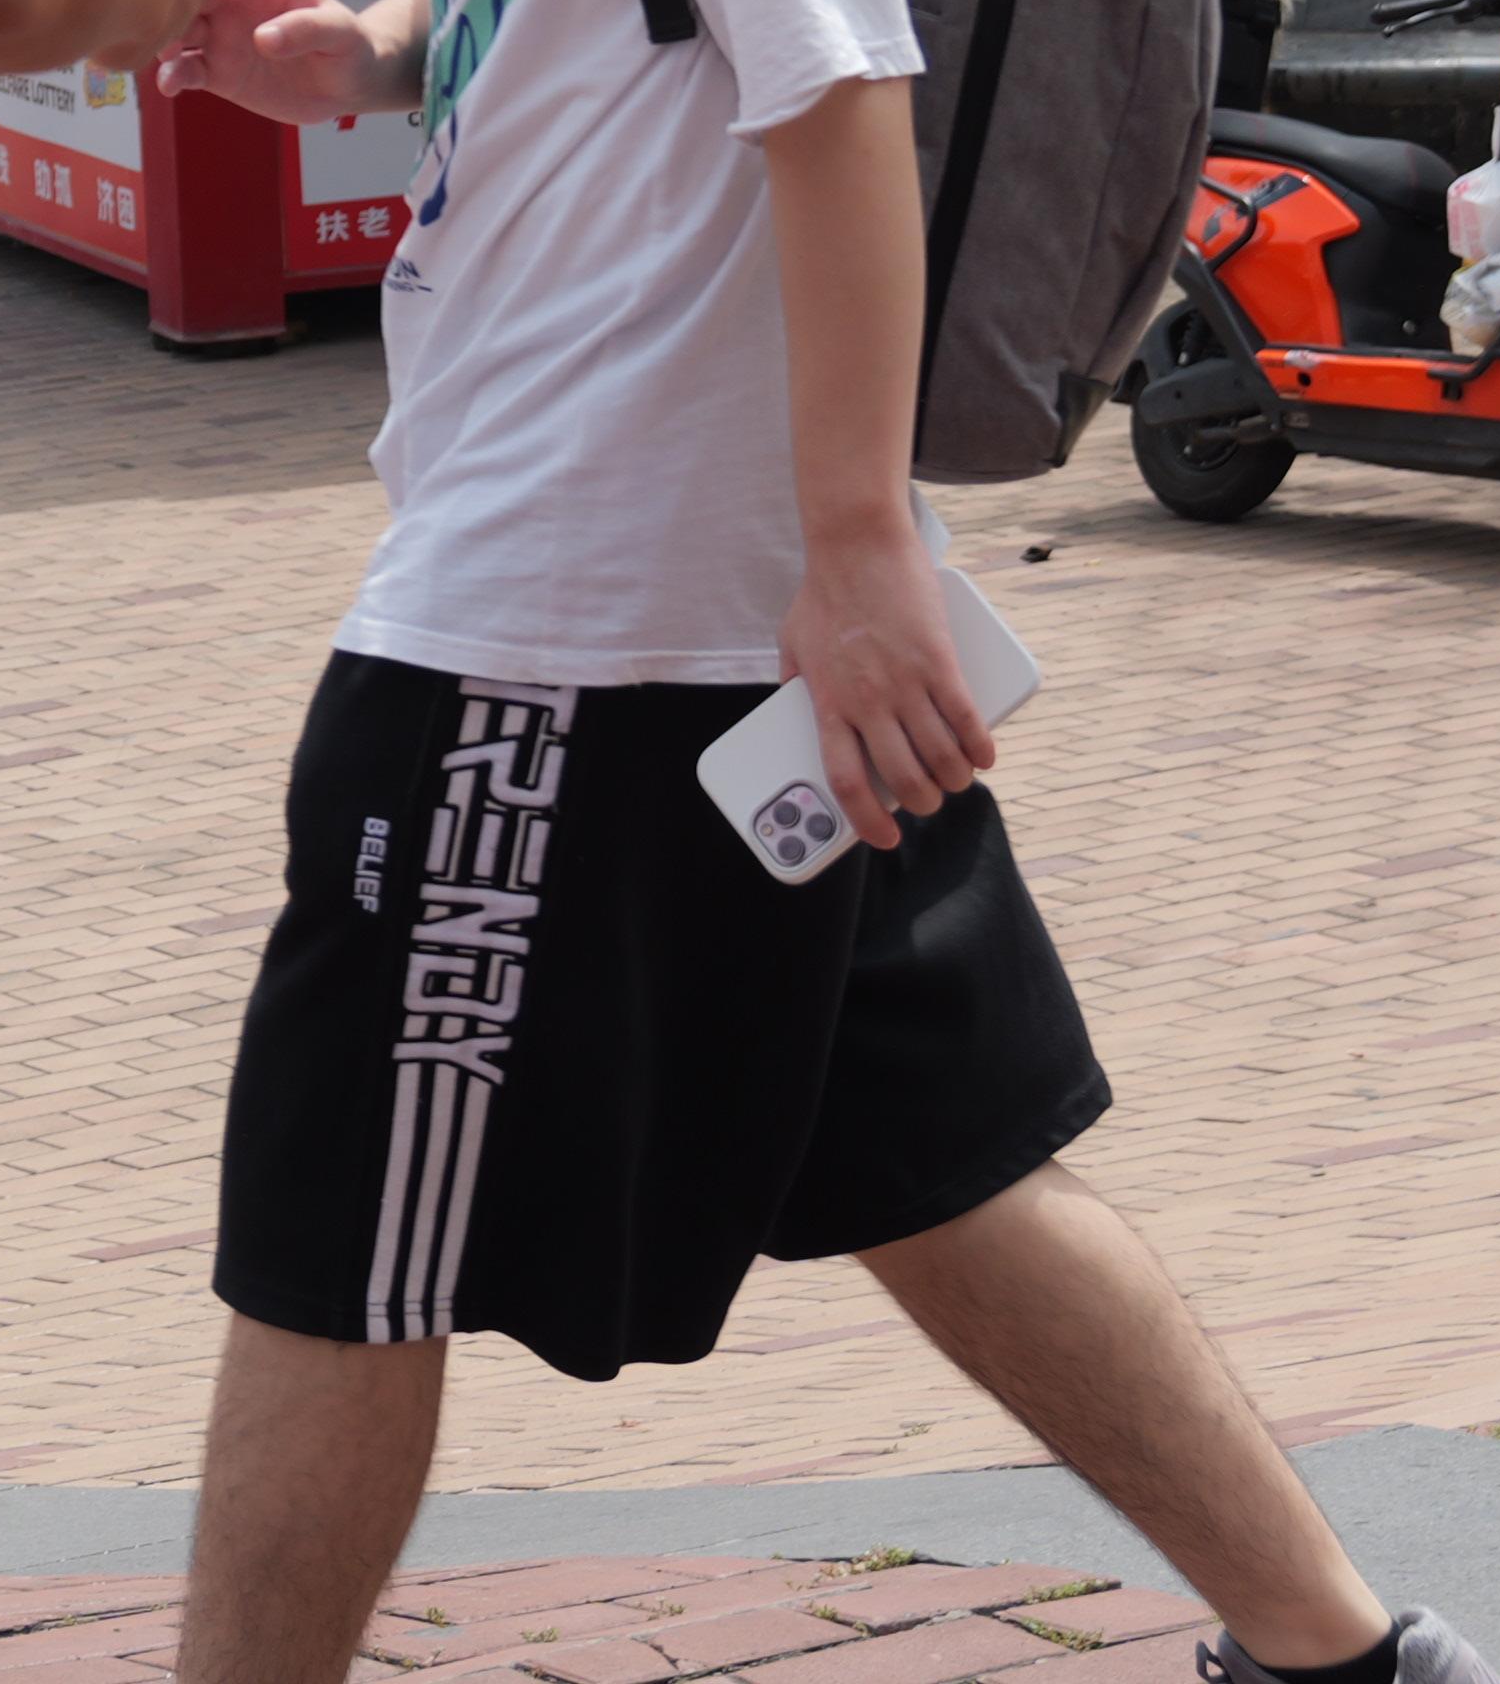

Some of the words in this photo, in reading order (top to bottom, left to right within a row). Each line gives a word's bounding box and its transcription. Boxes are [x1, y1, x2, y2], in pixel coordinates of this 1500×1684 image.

[30, 78, 75, 114] LOTTERY
[315, 205, 392, 245] 扶老
[353, 816, 390, 914] BELIEF
